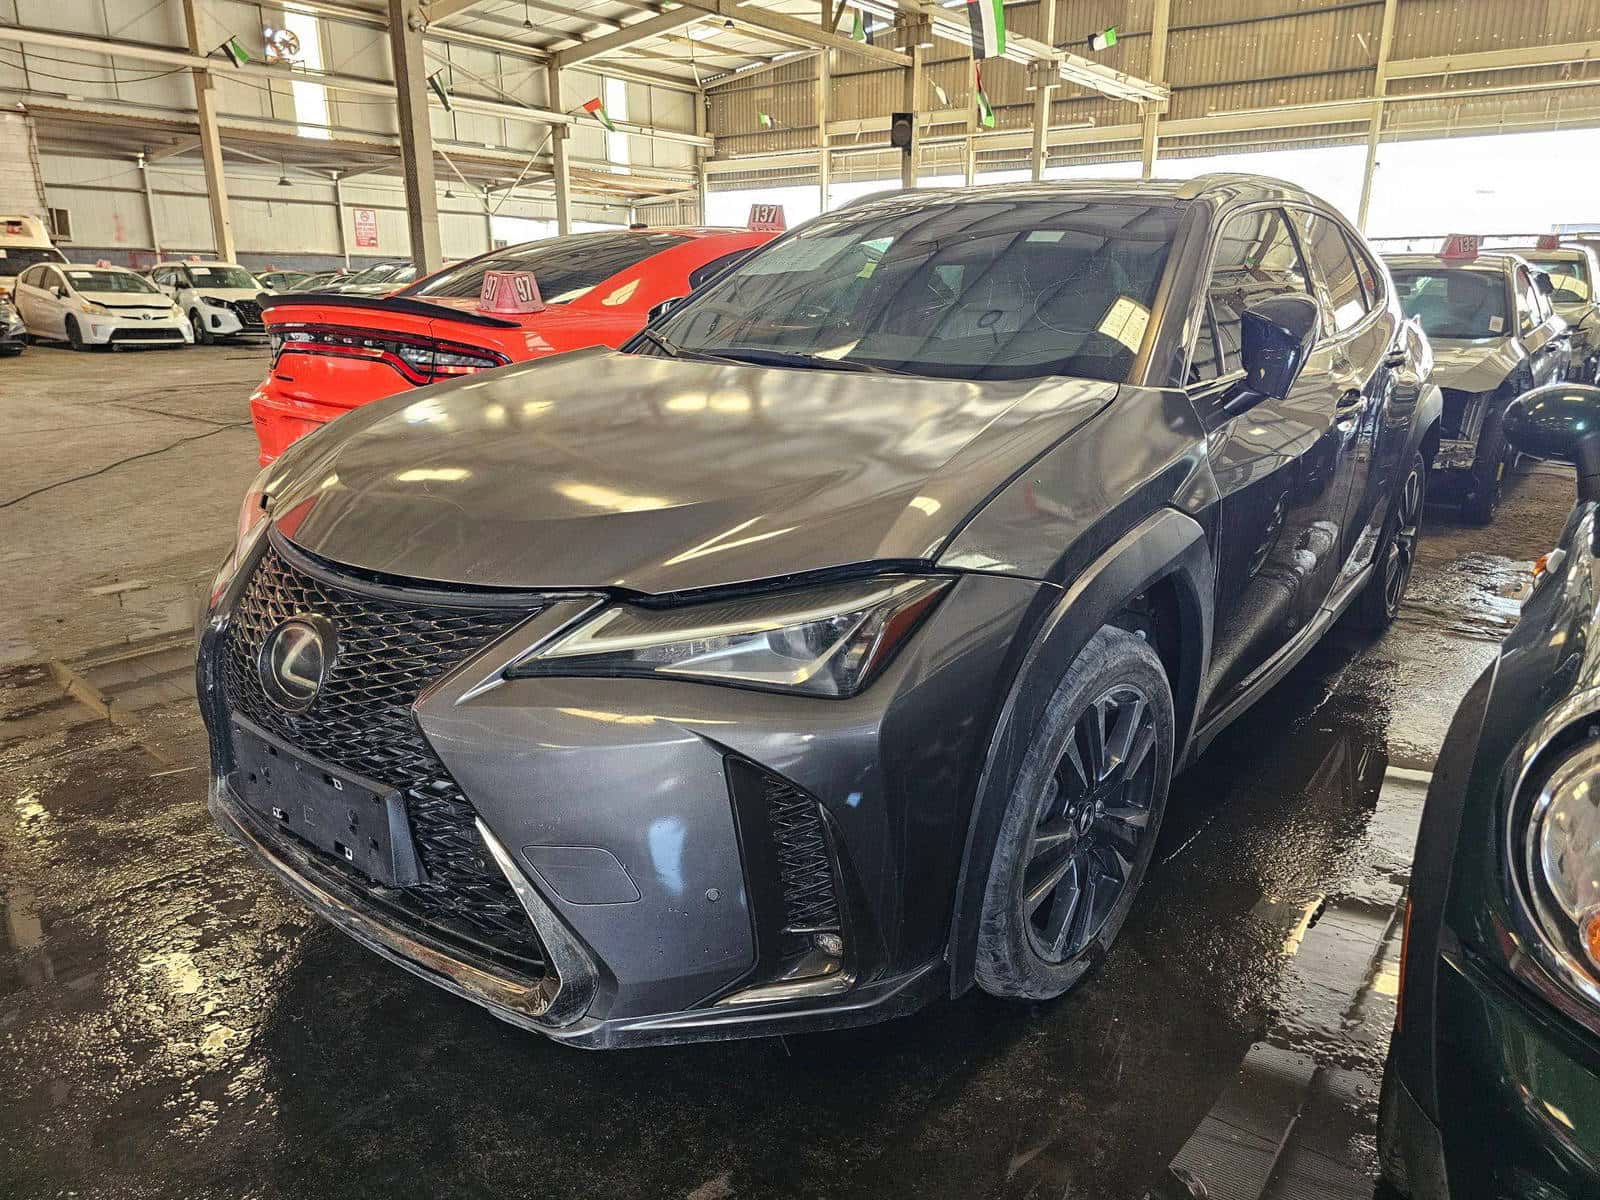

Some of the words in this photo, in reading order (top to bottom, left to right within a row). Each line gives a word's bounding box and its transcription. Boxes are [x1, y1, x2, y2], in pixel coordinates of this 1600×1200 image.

[754, 206, 777, 222] 137
[485, 275, 498, 301] 97
[515, 276, 533, 301] 97
